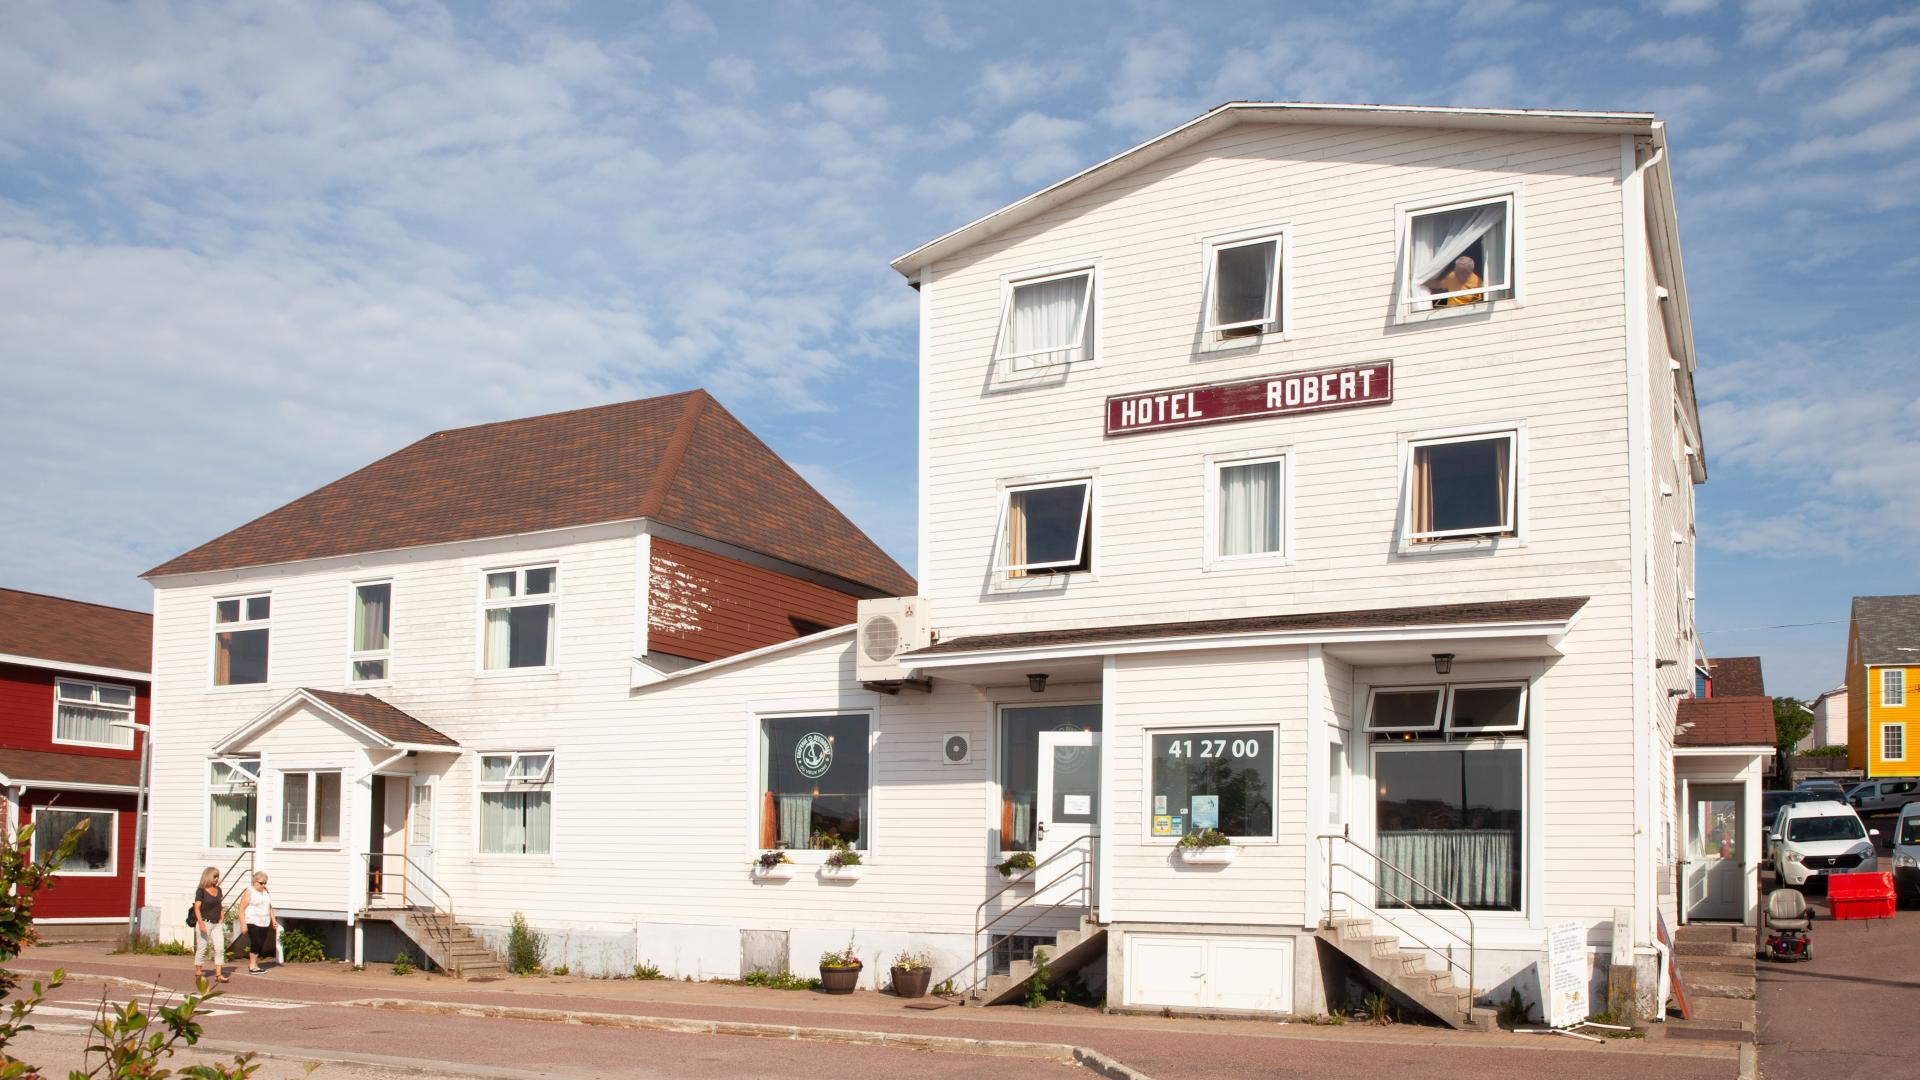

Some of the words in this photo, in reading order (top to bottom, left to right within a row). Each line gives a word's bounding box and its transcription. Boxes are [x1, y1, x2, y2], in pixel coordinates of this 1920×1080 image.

[1121, 392, 1202, 426] HOTEL
[1266, 369, 1375, 408] ROBERT
[1168, 740, 1192, 758] 41
[1200, 740, 1227, 758] 27
[1232, 739, 1259, 758] 00
